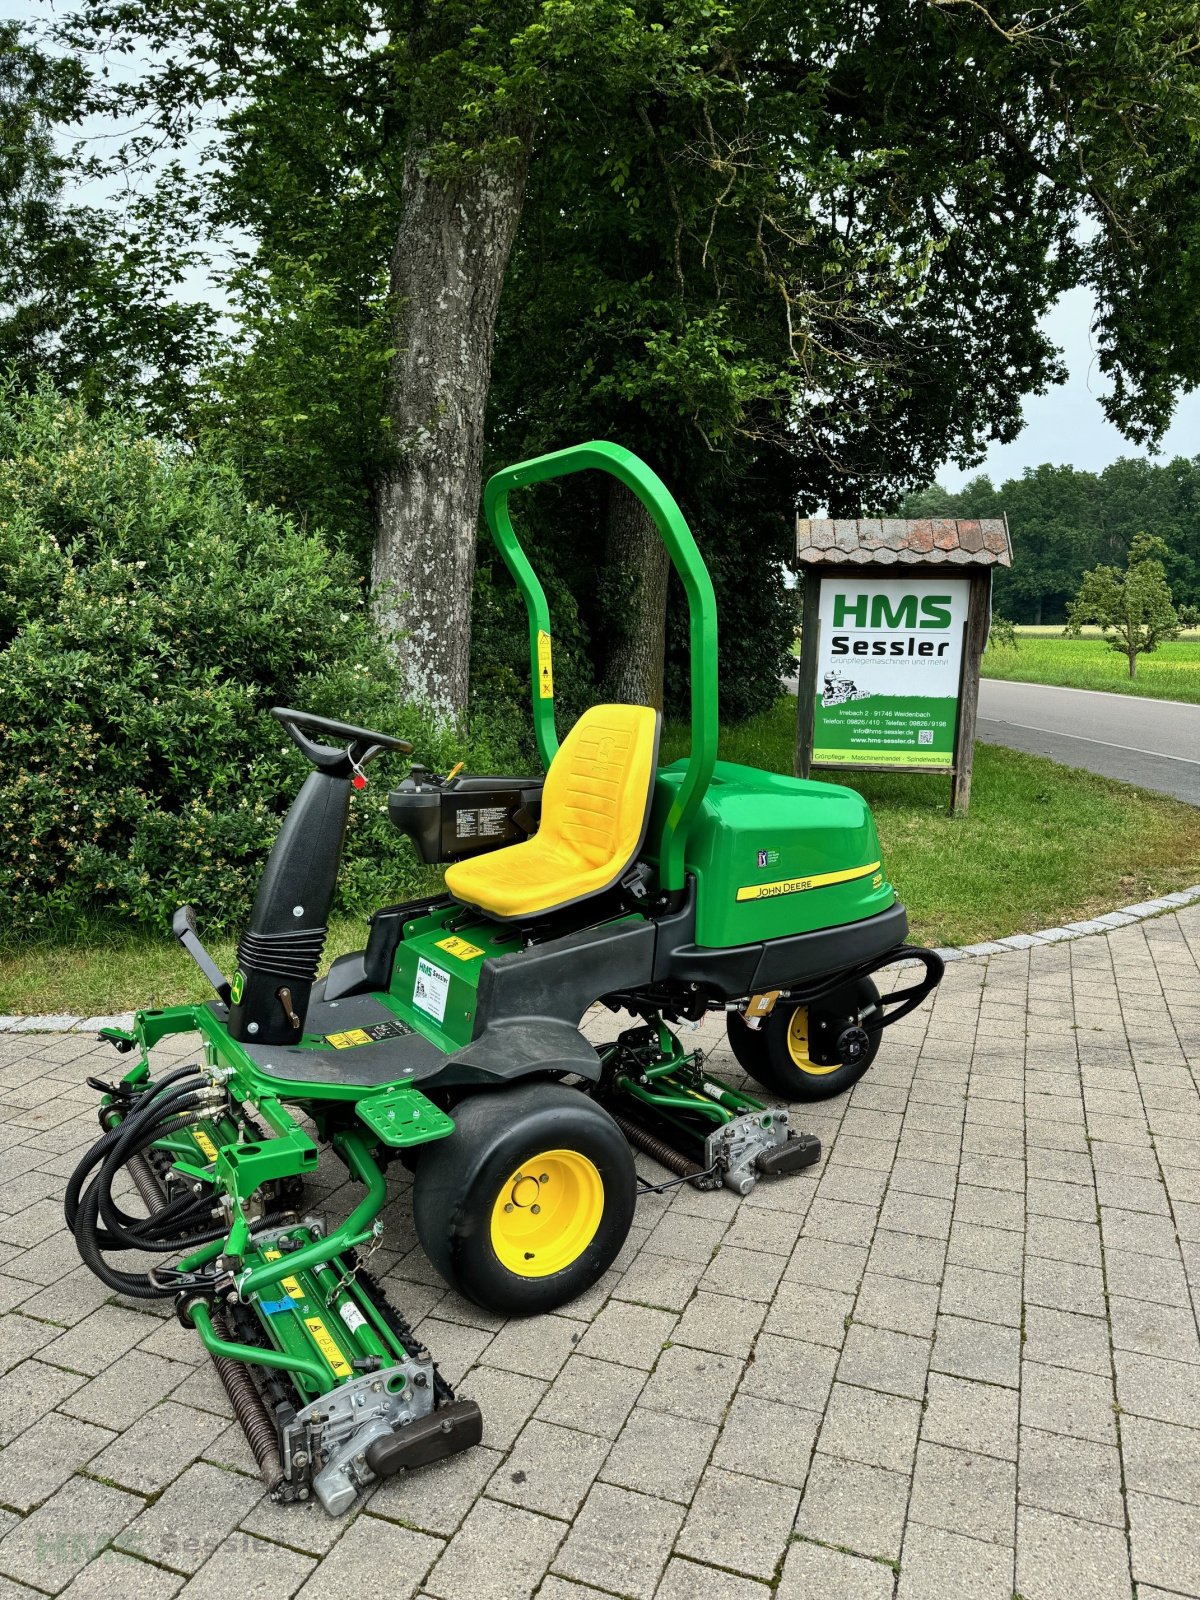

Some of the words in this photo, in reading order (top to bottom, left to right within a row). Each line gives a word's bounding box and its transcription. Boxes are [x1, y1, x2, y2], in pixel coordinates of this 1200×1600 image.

[833, 594, 952, 629] HMS
[831, 636, 949, 656] Sessler
[830, 656, 910, 666] Grünpflegemaschinen
[911, 657, 926, 666] und
[894, 710, 931, 718] Weidenbach
[853, 728, 914, 736] info@hms-sessler.de
[850, 737, 916, 745] www.hms-sessler.de
[814, 753, 846, 761] Grünpflege
[851, 754, 901, 762] Maschinenhandel
[906, 755, 951, 764] Spindelwartung
[757, 886, 782, 898] JOHN
[783, 880, 812, 892] DEERE
